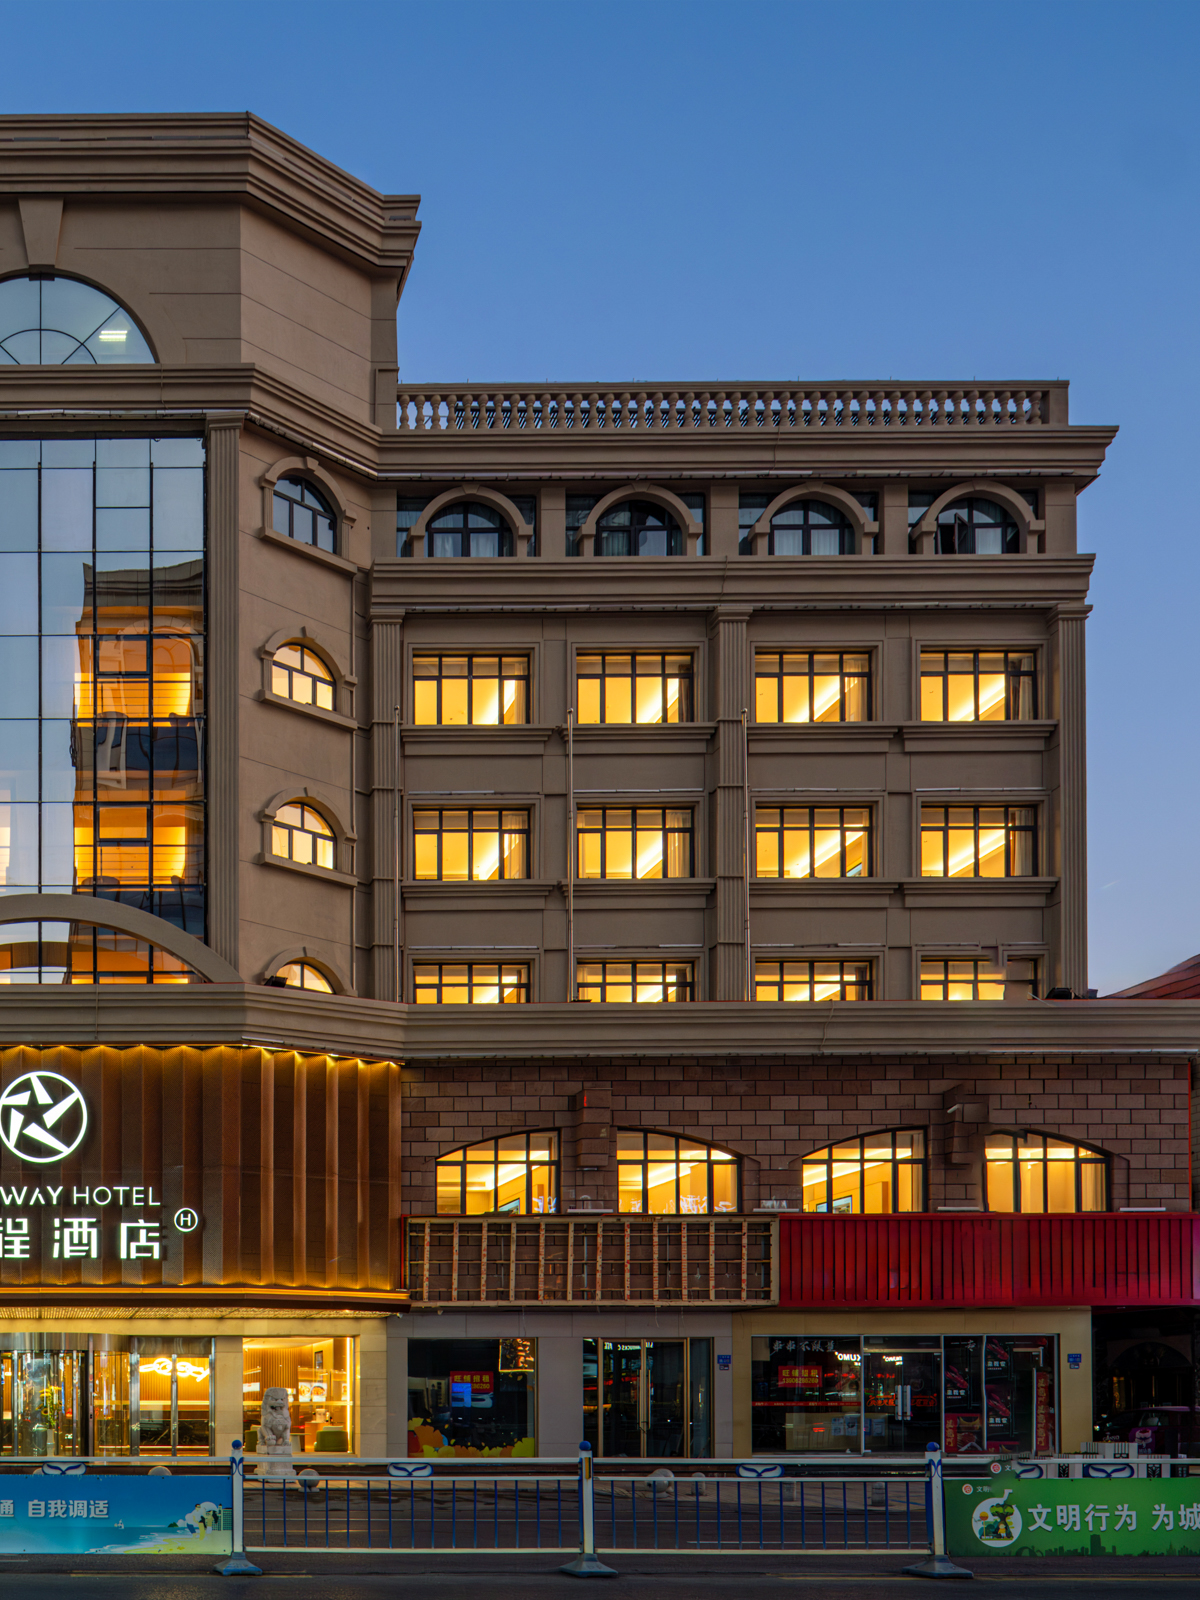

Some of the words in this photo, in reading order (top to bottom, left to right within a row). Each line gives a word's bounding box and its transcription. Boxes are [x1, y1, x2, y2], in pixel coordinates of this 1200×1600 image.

[73, 1186, 161, 1206] HOTEL
[27, 1499, 109, 1519] 自我调适
[1027, 1503, 1138, 1532] 文明行为
